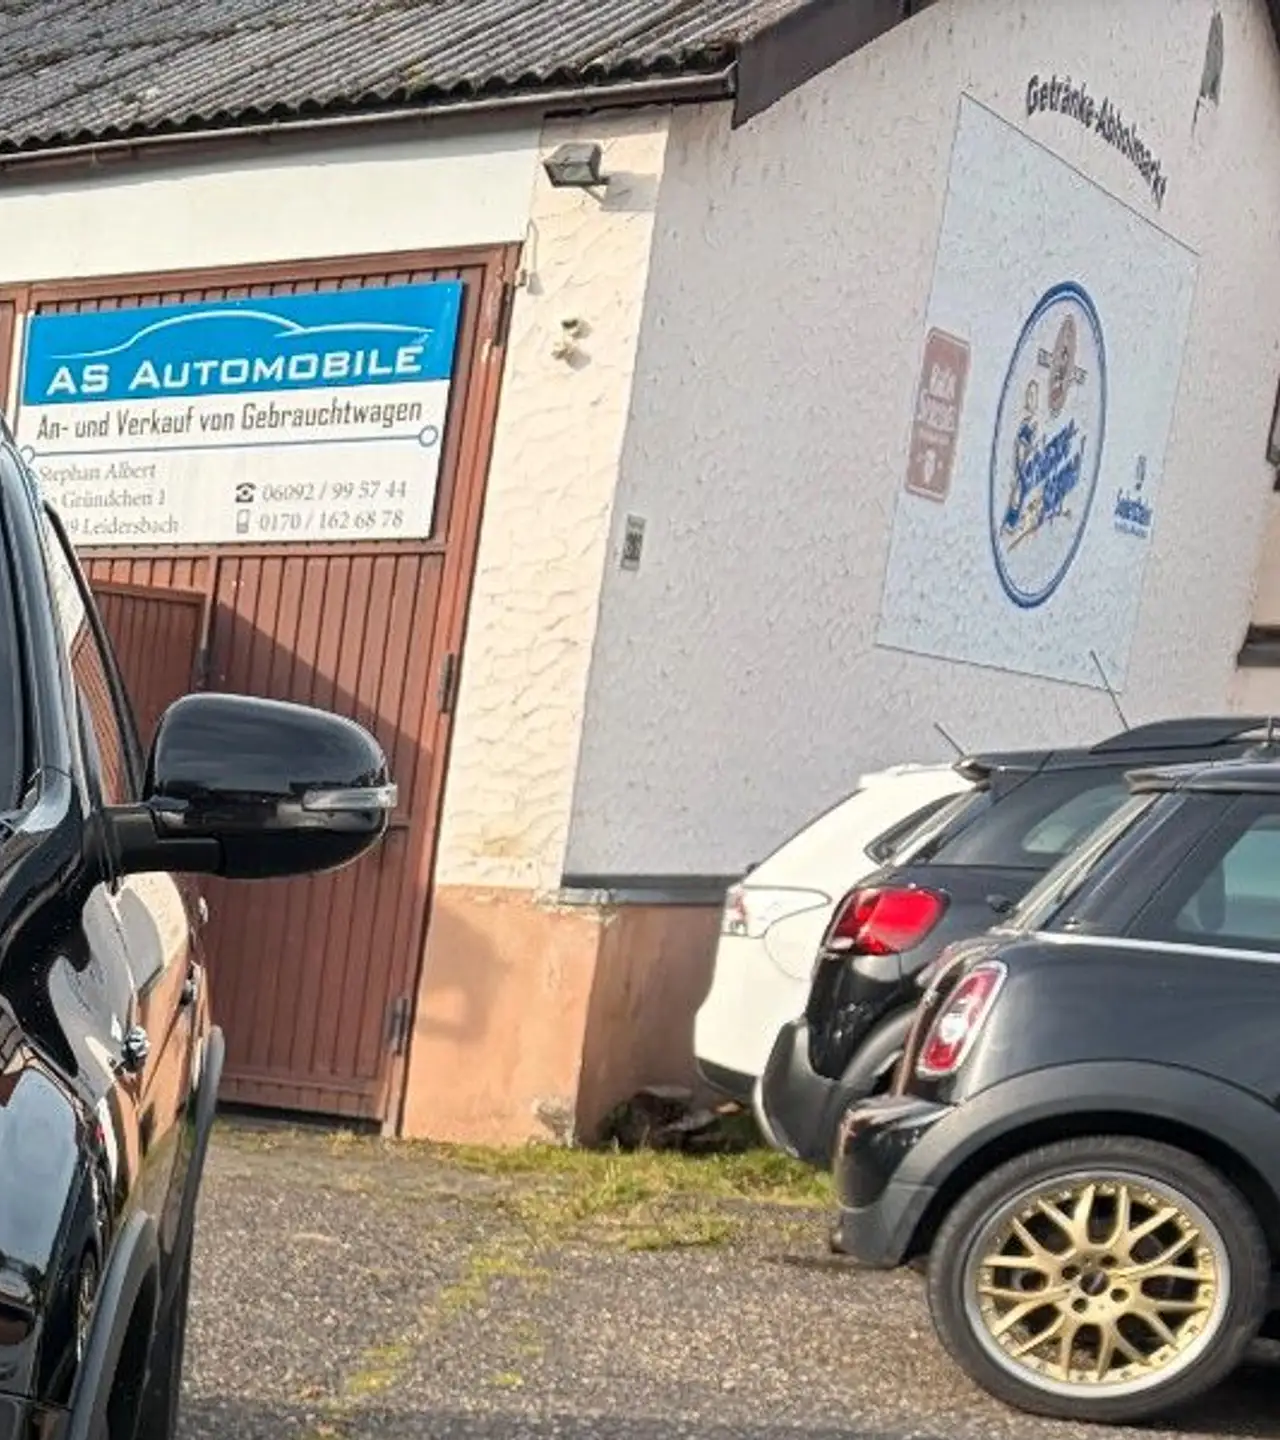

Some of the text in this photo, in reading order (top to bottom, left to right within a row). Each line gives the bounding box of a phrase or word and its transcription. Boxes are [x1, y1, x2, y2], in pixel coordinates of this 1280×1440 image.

[46, 344, 425, 396] AS AUTOMOBILE
[37, 396, 423, 440] An- und Verkauf von Gebrauchtwagen
[104, 460, 157, 482] Albert
[262, 482, 315, 503] 06092
[385, 479, 408, 499] 44
[82, 514, 180, 535] Leidersbach
[258, 511, 303, 532] 0170
[319, 510, 351, 530] 162
[381, 508, 404, 529] 78
